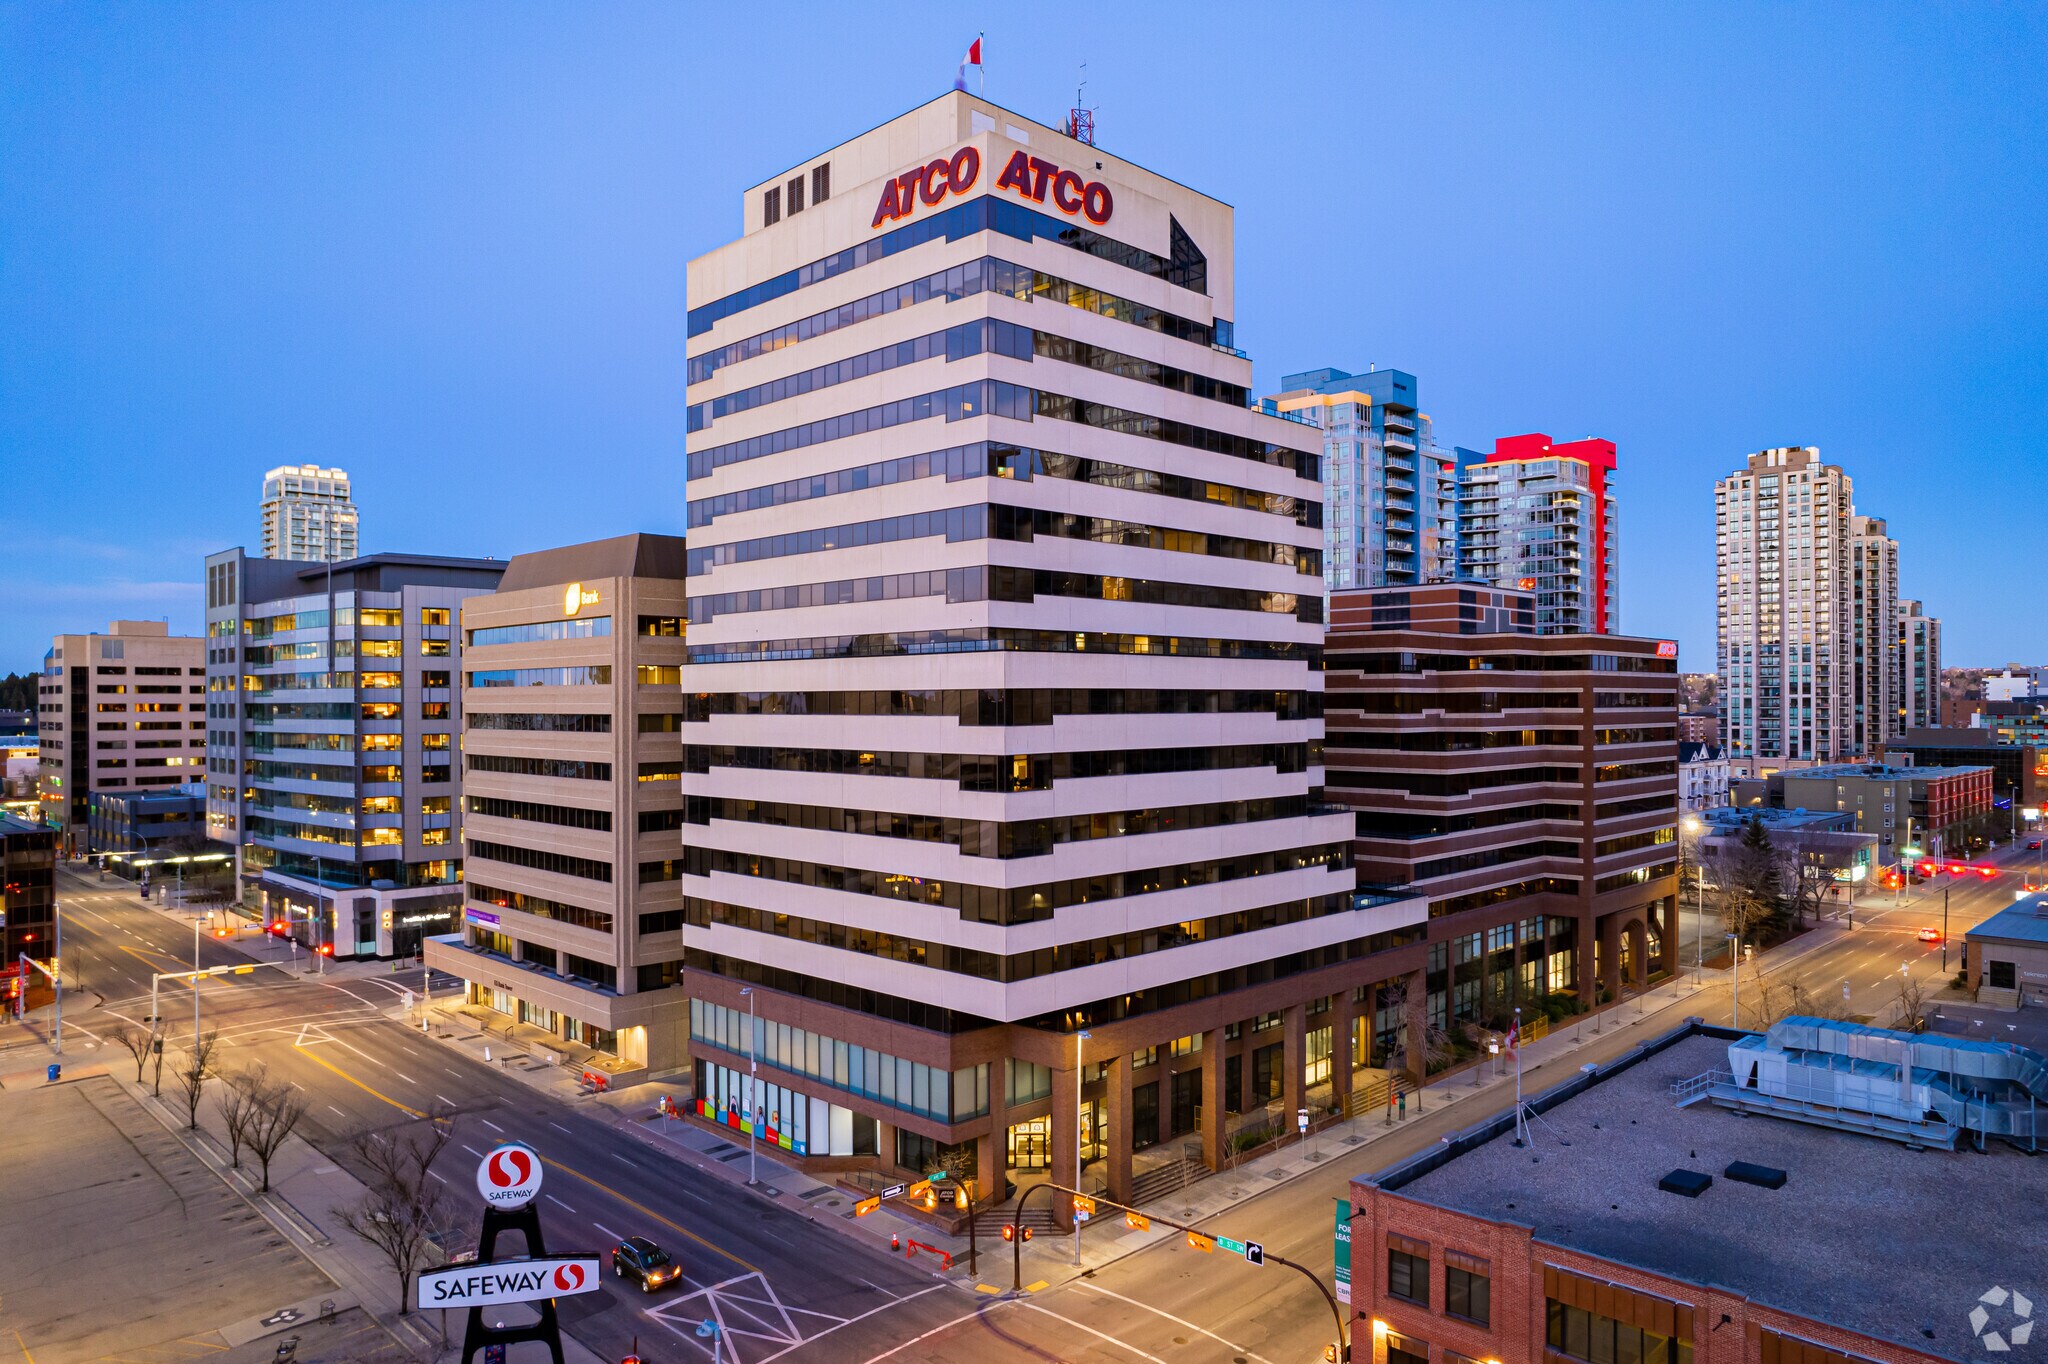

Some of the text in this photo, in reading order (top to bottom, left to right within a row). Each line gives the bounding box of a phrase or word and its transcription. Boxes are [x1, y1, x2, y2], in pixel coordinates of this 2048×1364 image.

[871, 146, 981, 229] ATCO
[995, 150, 1114, 226] ATCO
[489, 1189, 533, 1201] SAFEWAY
[1335, 1232, 1351, 1243] LEAS
[434, 1270, 548, 1301] SAFEWAY
